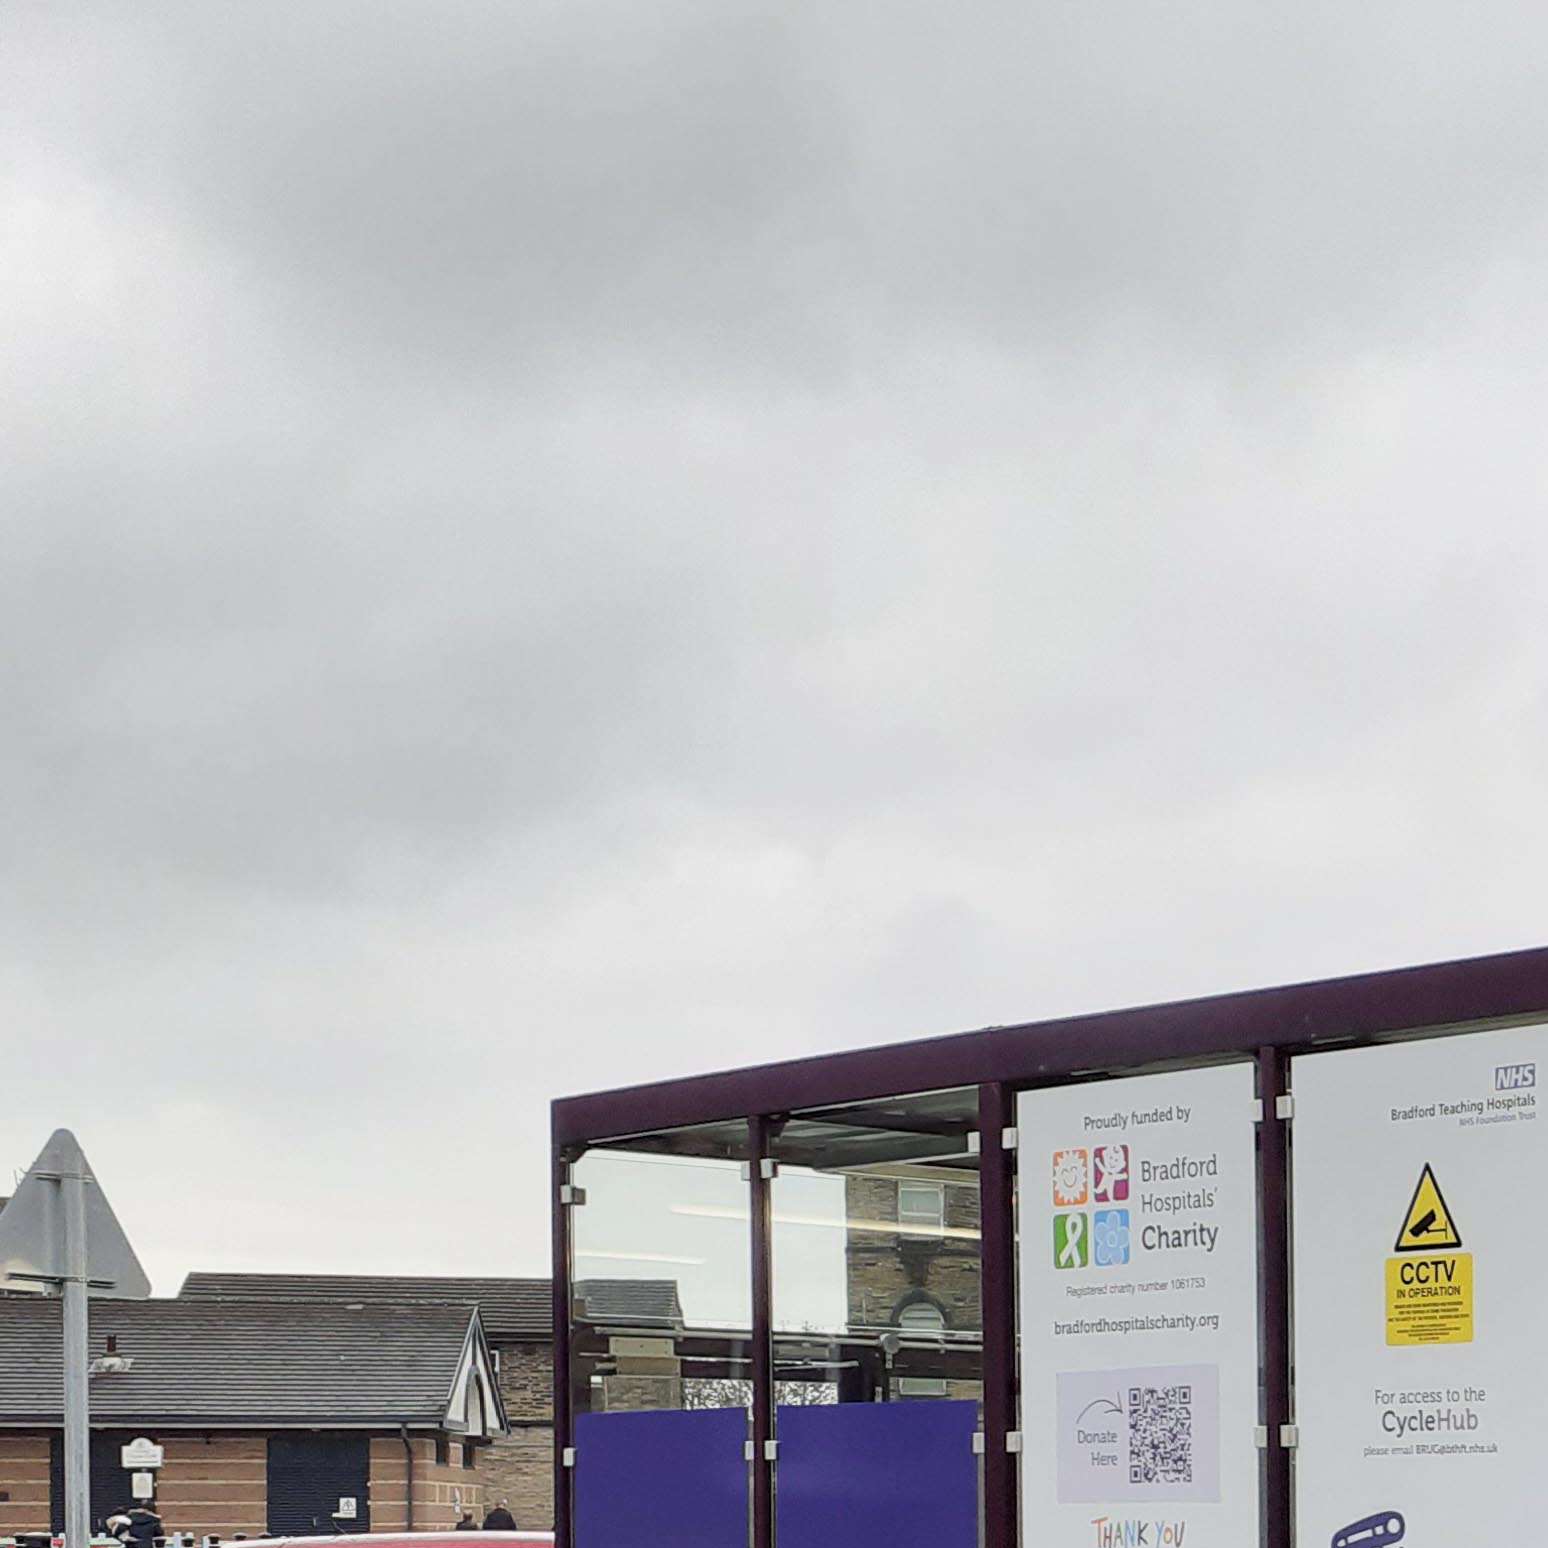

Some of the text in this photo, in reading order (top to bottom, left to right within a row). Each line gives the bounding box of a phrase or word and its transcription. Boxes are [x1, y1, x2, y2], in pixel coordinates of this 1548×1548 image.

[1496, 1064, 1535, 1090] NHS
[1391, 1093, 1536, 1120] Bradford Teaching Hospitals
[1084, 1106, 1191, 1130] Proudly funded by
[1459, 1116, 1474, 1126] NHS
[1140, 1154, 1218, 1182] Bradford
[1142, 1222, 1219, 1252] Charity
[1400, 1260, 1456, 1285] CCTV
[1066, 1285, 1108, 1299] Registered
[1109, 1284, 1136, 1296] charity
[1138, 1282, 1168, 1292] number
[1396, 1286, 1461, 1298] IN OPERATION
[1054, 1313, 1220, 1335] bradfordhospitalscharity.org
[1375, 1387, 1486, 1405] For access to the
[1382, 1408, 1479, 1438] CycleHub
[1077, 1429, 1118, 1444] Donate
[1091, 1452, 1118, 1466] Here
[1363, 1445, 1389, 1457] please
[1392, 1444, 1413, 1454] email
